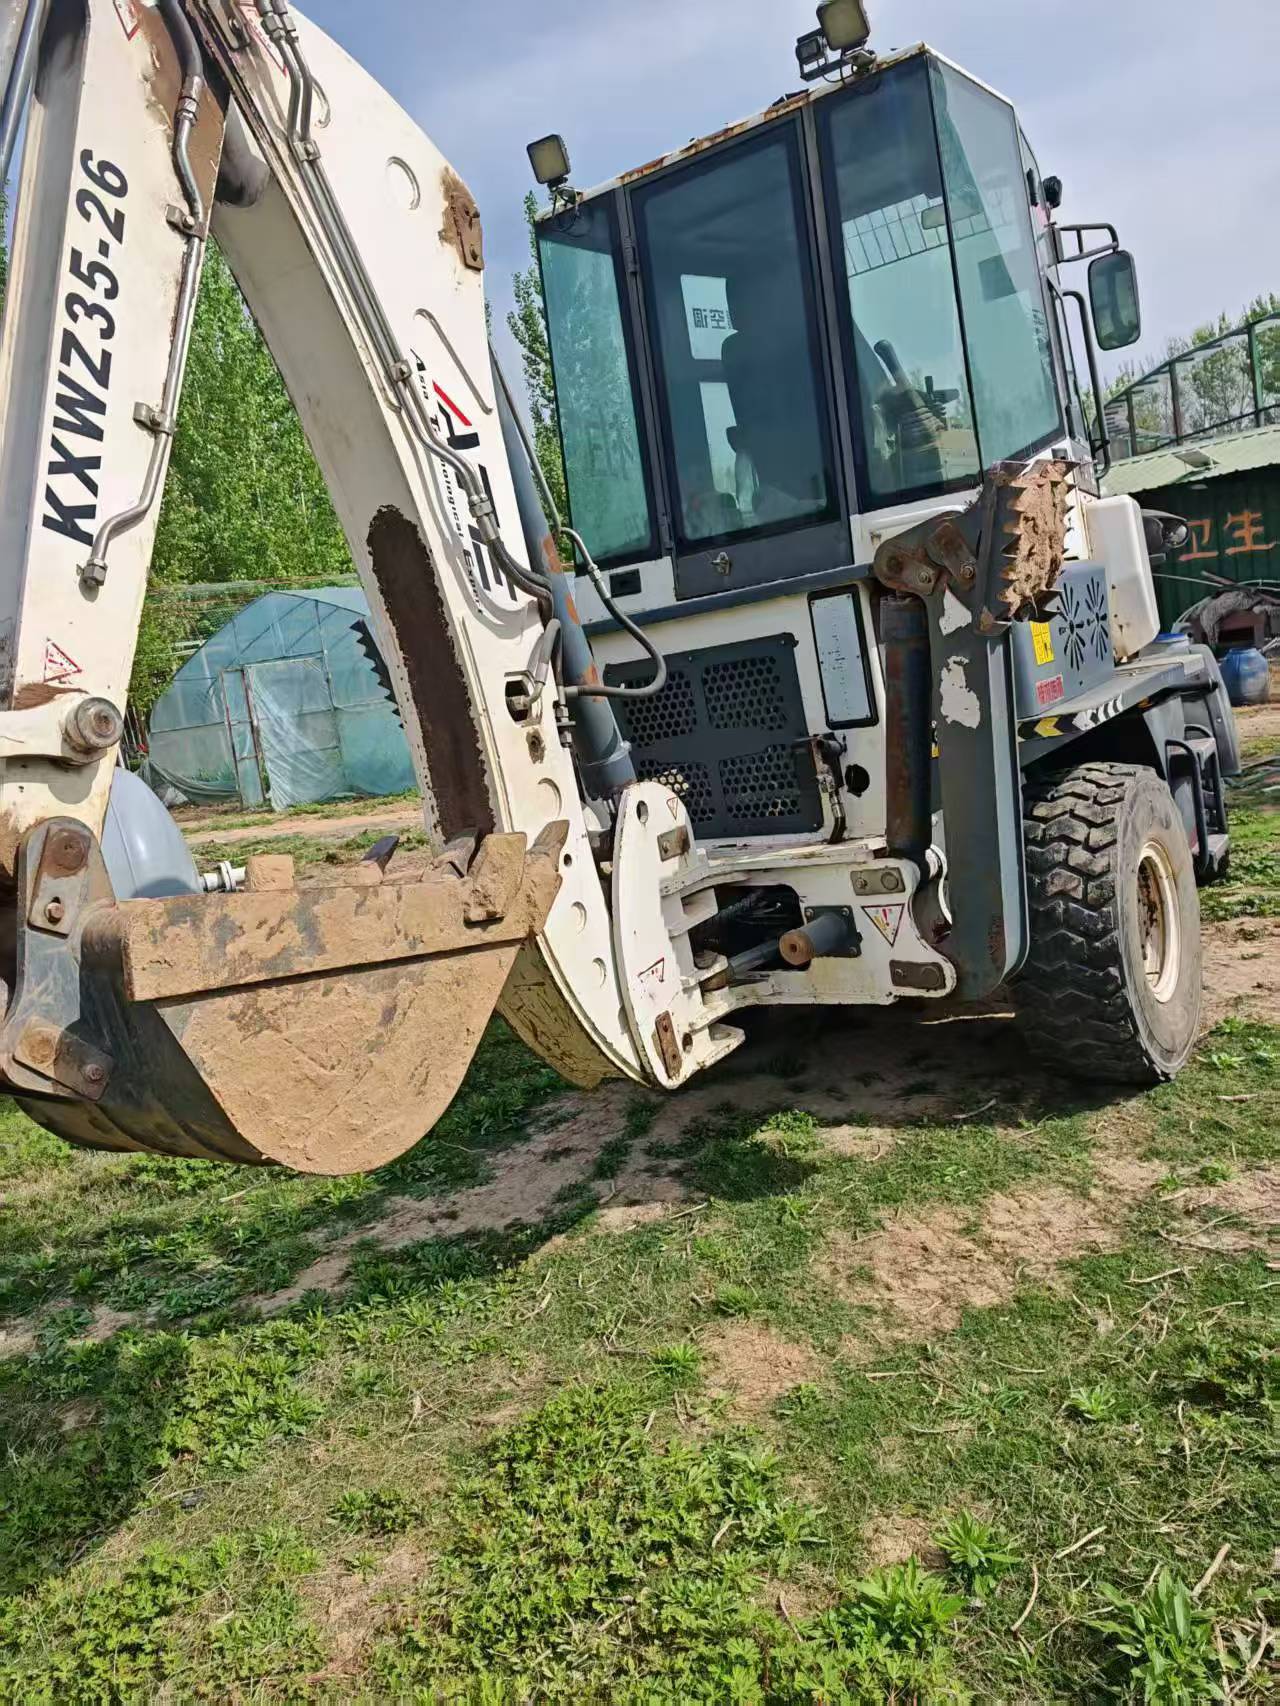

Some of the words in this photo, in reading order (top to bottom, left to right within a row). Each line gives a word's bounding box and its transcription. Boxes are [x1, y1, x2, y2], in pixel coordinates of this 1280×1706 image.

[42, 148, 128, 547] KXWZ35-26
[410, 348, 430, 400] Asia
[1178, 511, 1276, 562] 卫生
